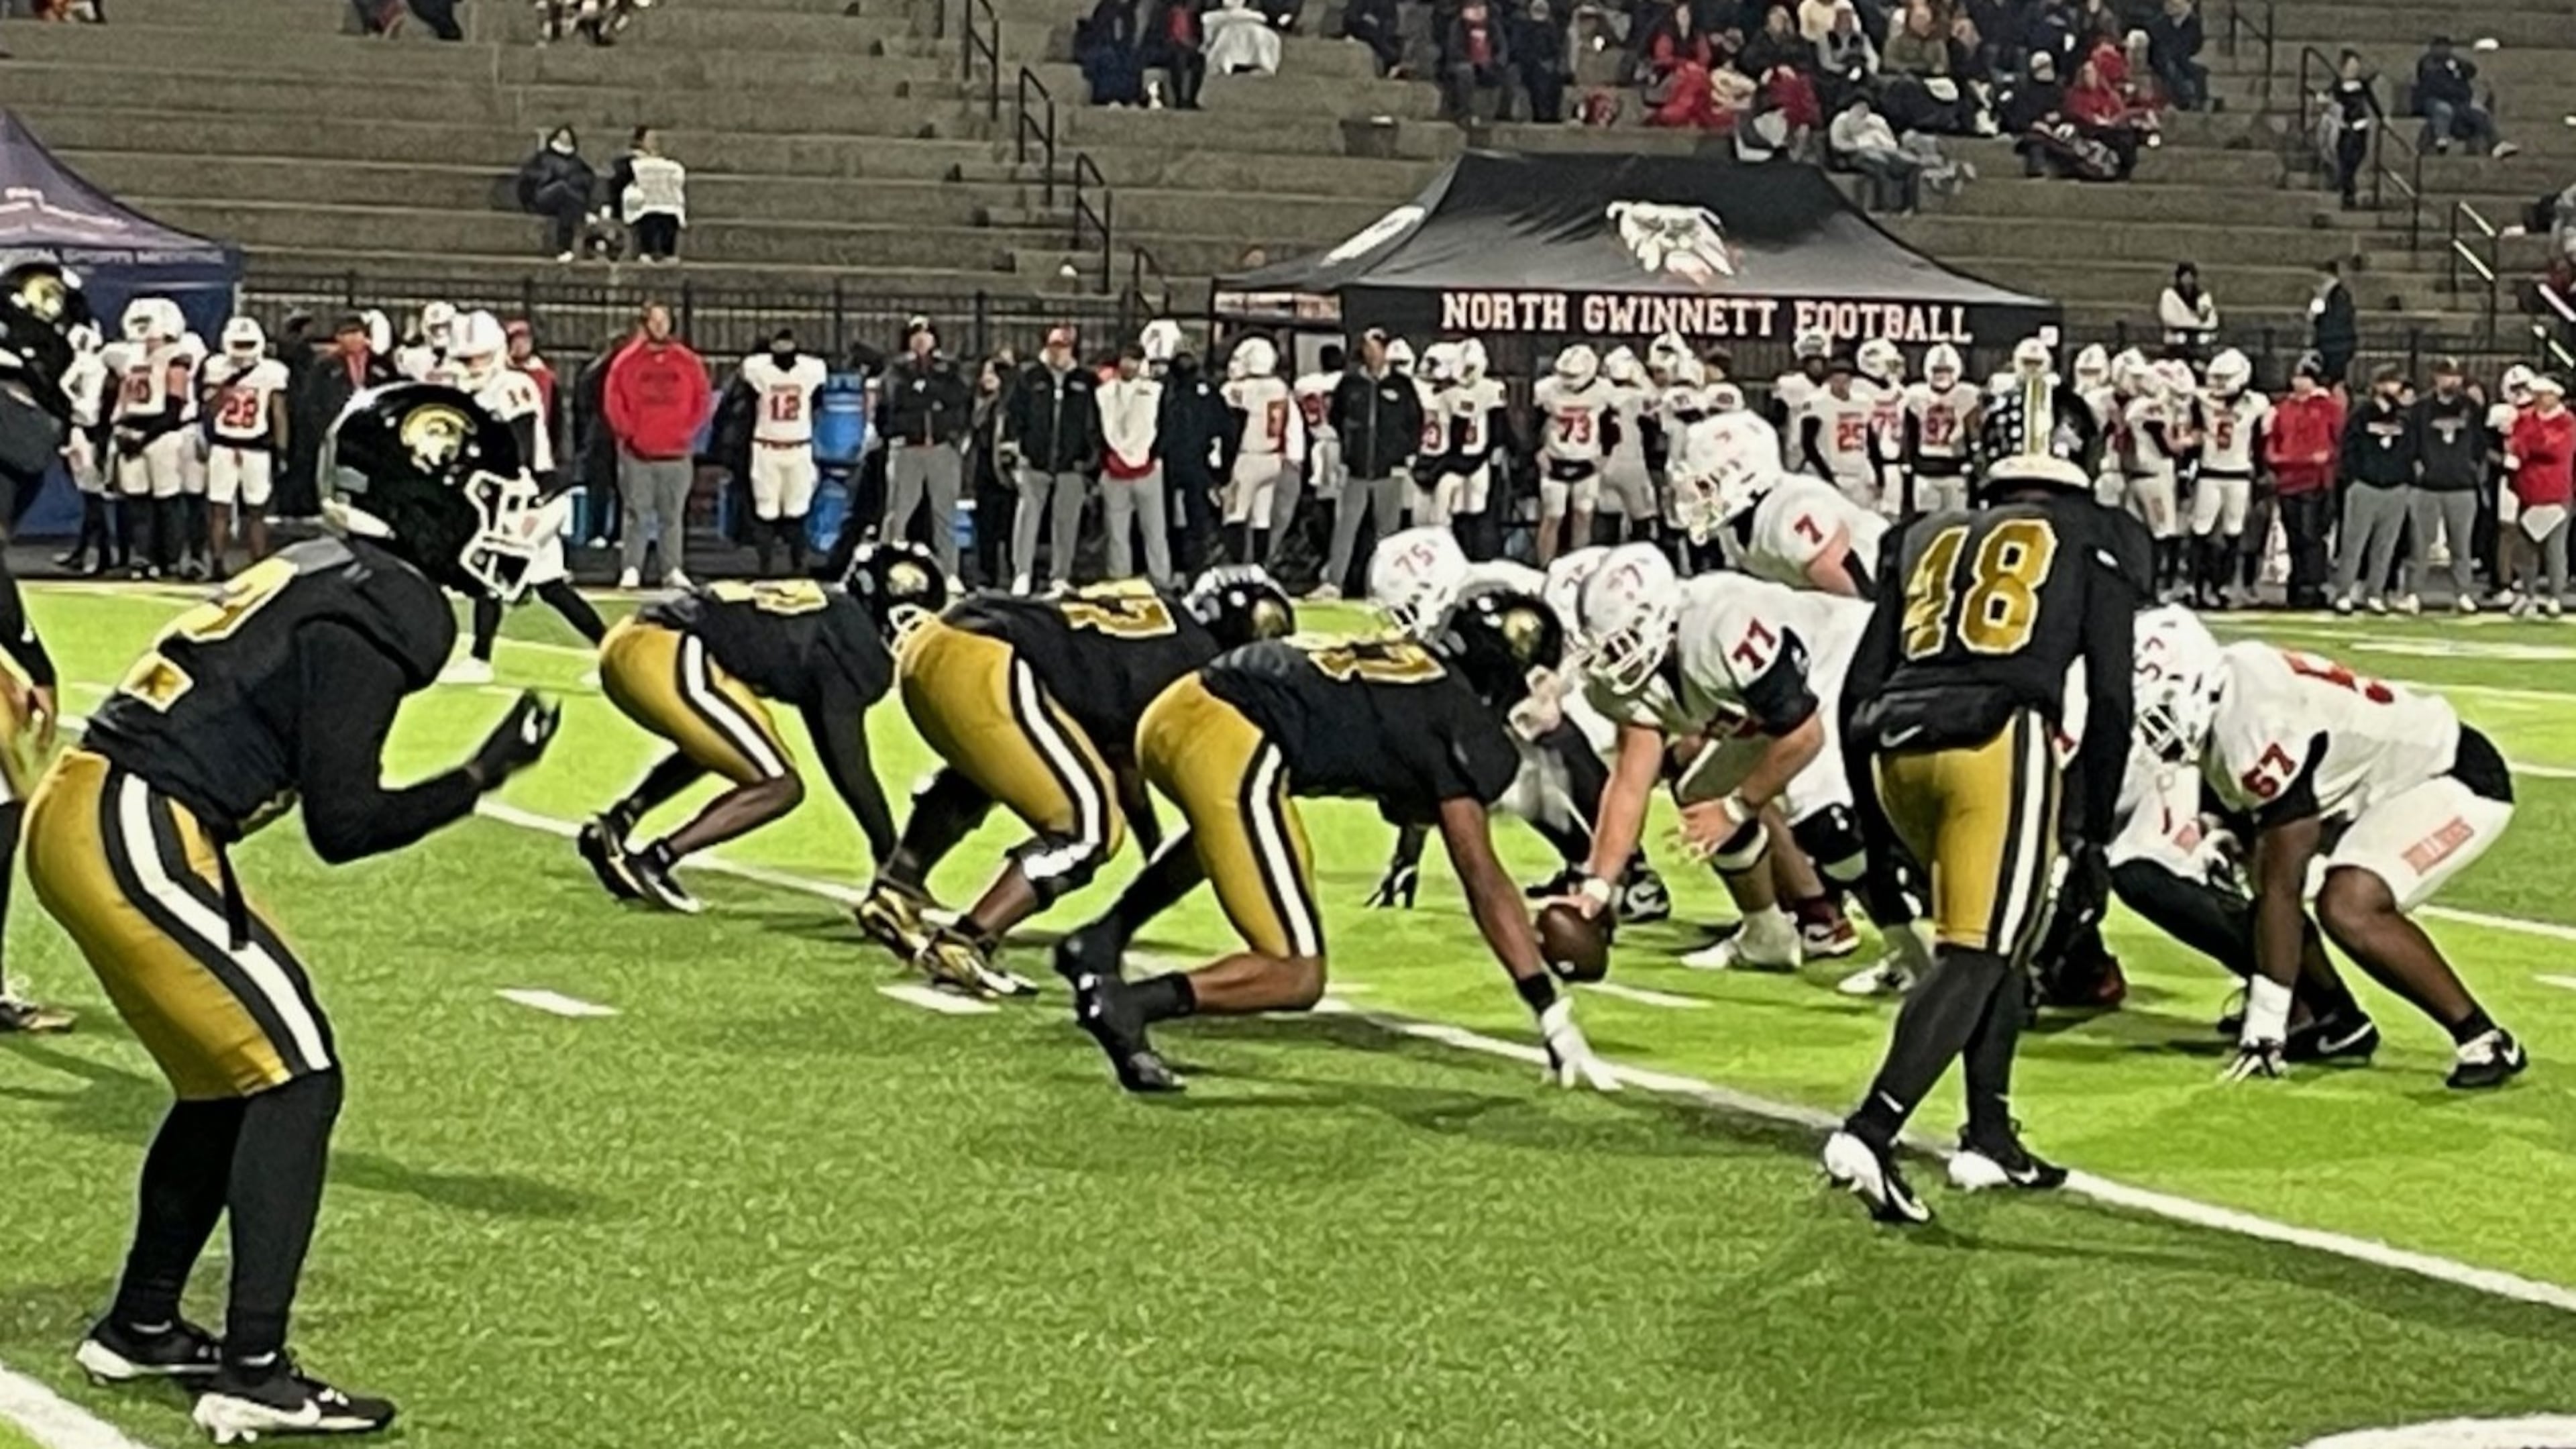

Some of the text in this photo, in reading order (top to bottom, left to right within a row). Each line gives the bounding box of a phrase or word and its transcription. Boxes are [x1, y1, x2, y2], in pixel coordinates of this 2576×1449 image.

[1441, 292, 1973, 343] NORTH GWINNETT FOOTBALL
[771, 394, 801, 421] 12
[1558, 415, 1591, 444] 73
[1837, 423, 1865, 453] 25
[1793, 514, 1823, 545] 7
[1393, 541, 1435, 578] 75
[1901, 519, 2058, 660] 48
[1731, 616, 1777, 671] 77
[2241, 741, 2297, 799] 57
